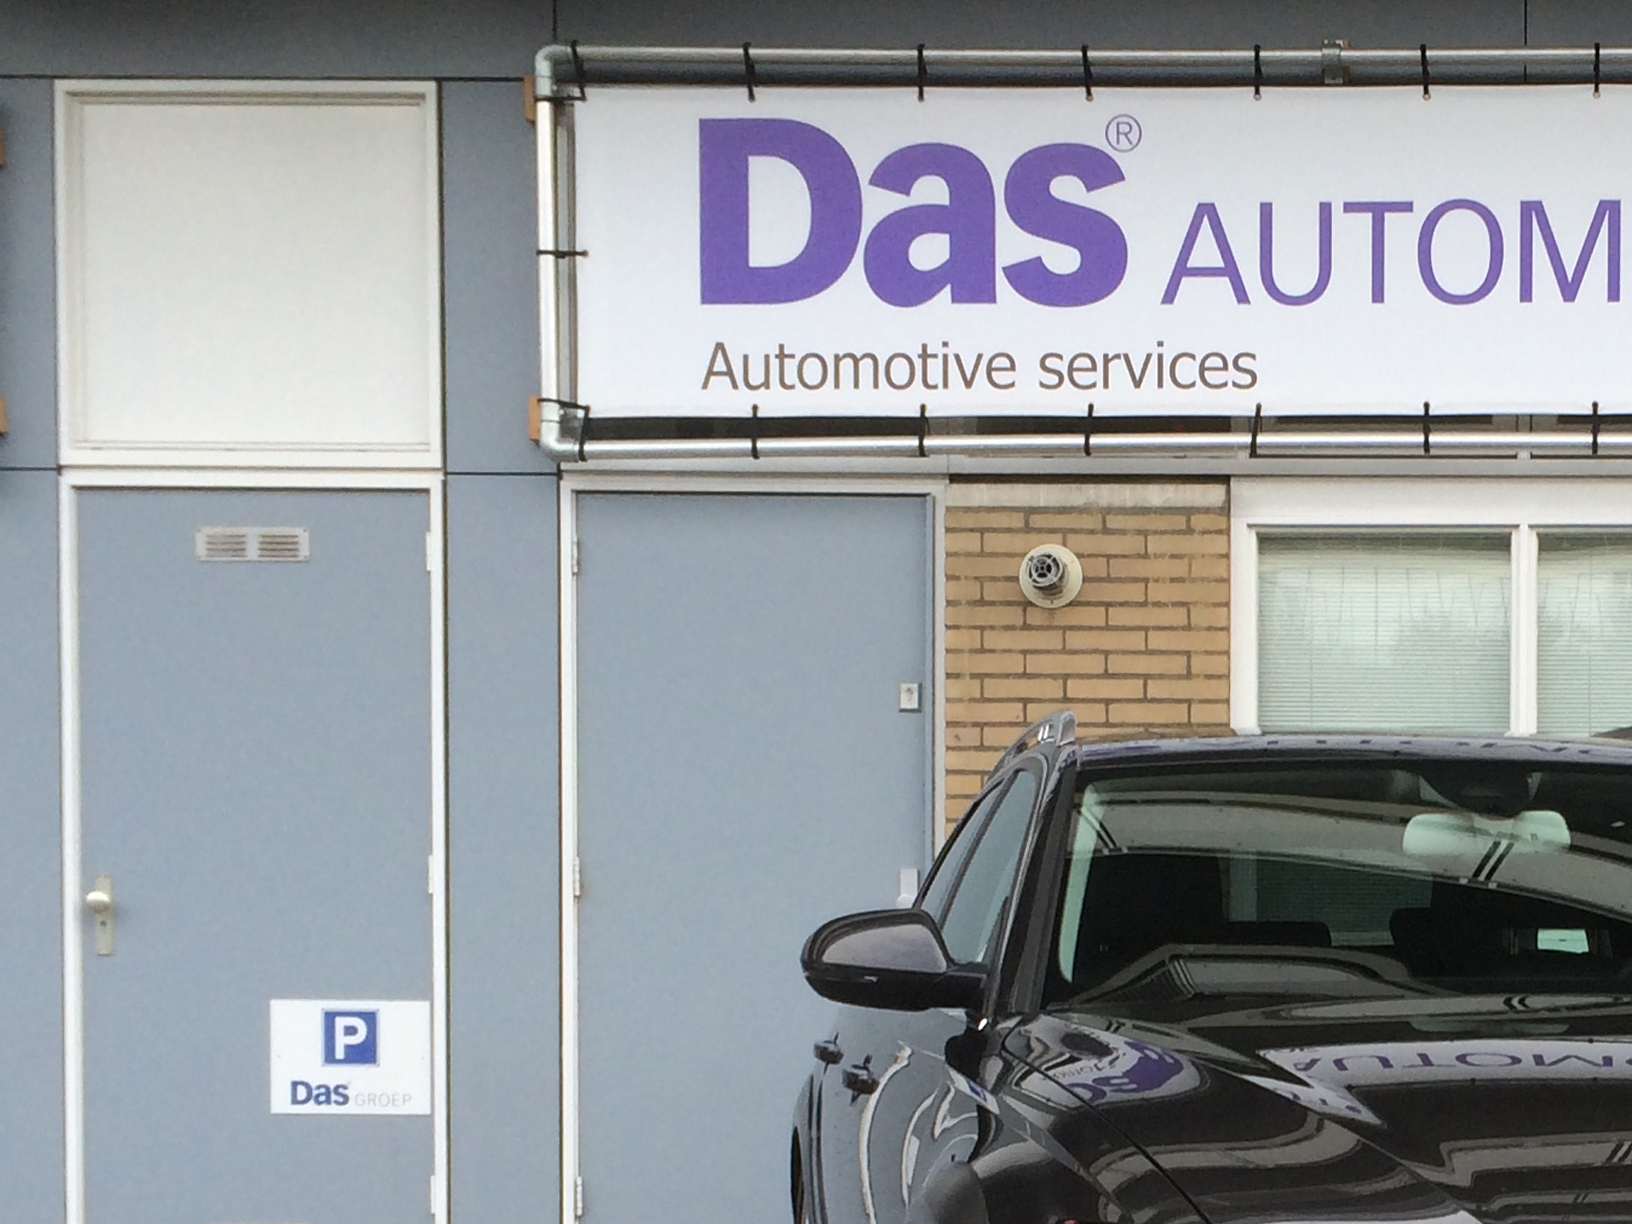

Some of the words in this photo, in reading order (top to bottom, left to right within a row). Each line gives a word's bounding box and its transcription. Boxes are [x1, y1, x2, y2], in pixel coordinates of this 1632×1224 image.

[701, 341, 1016, 391] Automotive
[1037, 341, 1258, 391] services
[334, 1016, 367, 1060] P
[290, 1080, 350, 1106] Das
[355, 1092, 412, 1107] GROEP
